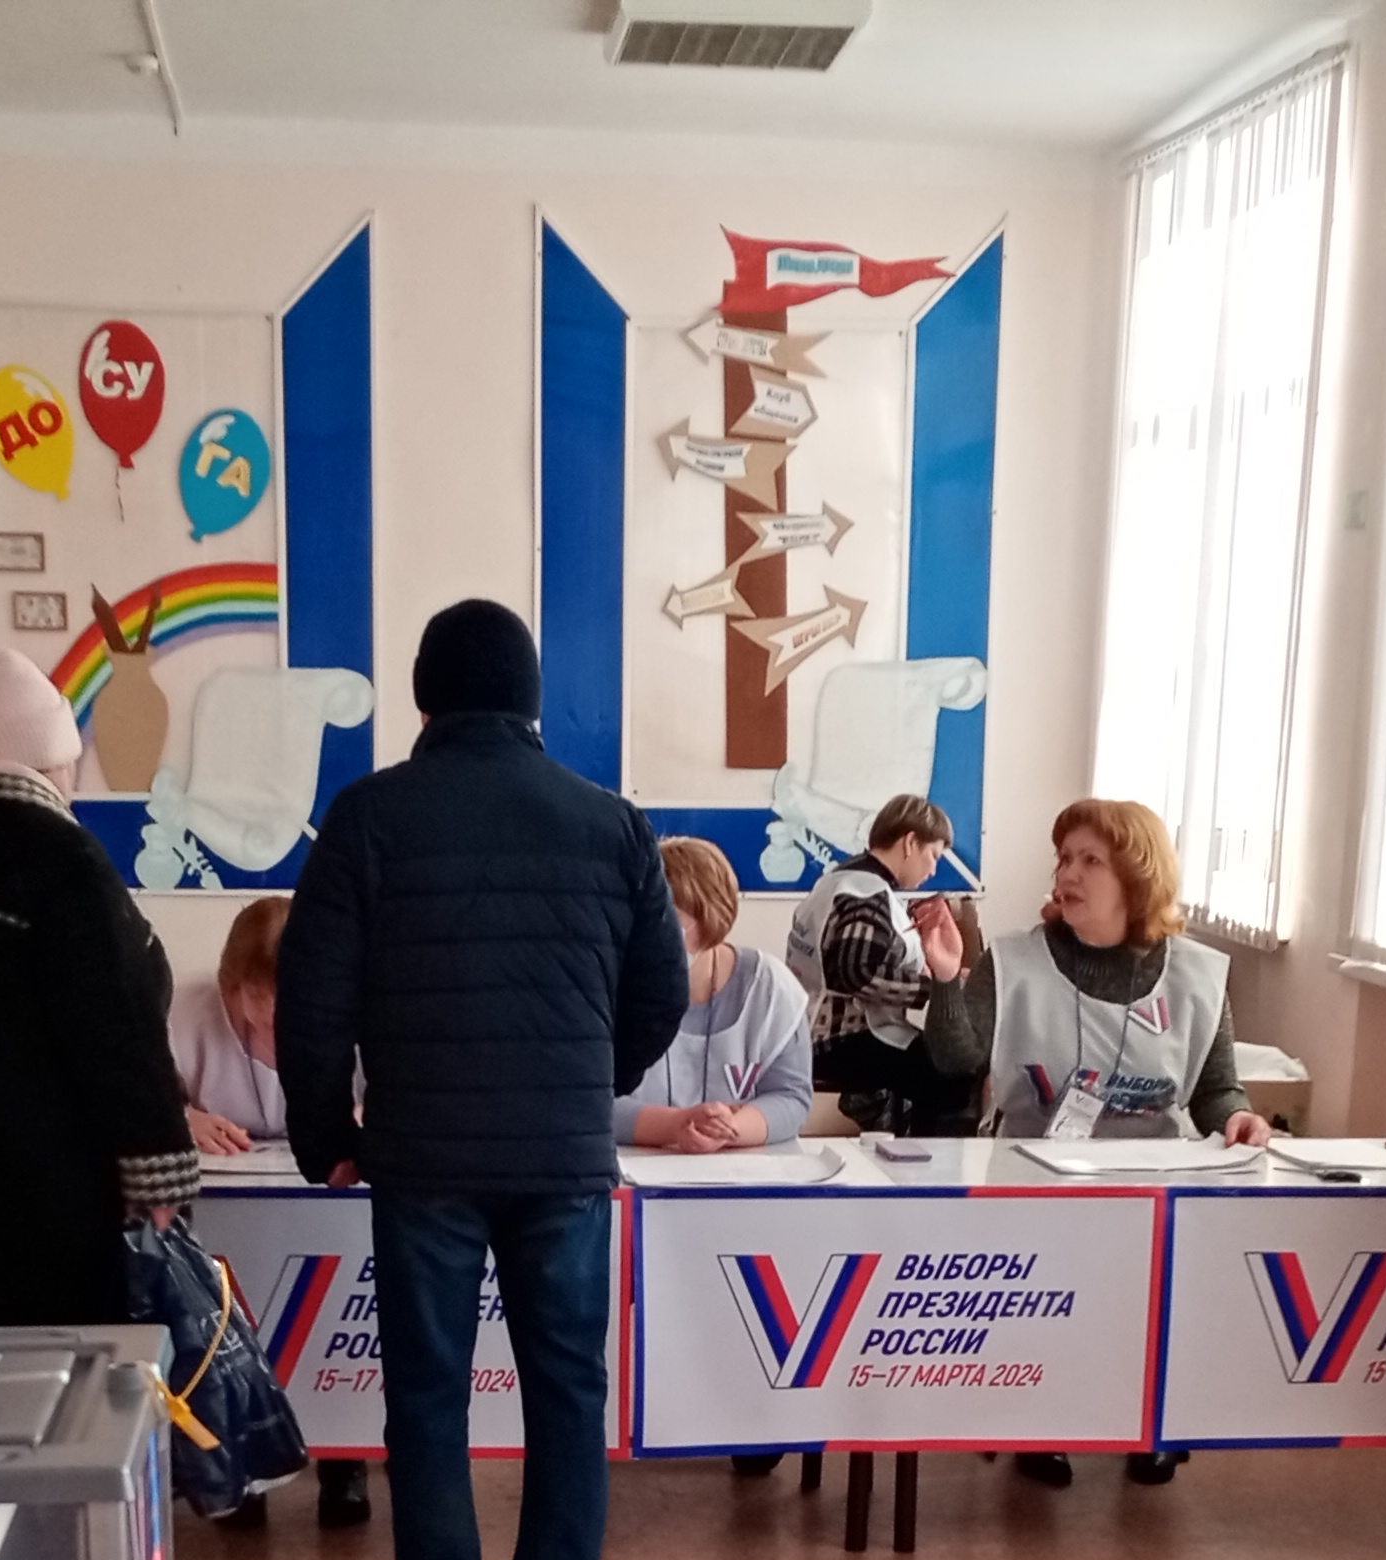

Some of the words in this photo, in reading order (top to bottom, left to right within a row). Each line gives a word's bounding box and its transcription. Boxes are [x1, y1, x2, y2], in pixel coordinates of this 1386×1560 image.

[194, 442, 253, 498] ГА
[894, 1253, 1039, 1281] ВЫБОРЫ
[876, 1290, 1076, 1322] ПРЕЗИДЕНТА
[324, 1332, 383, 1360] РОС
[859, 1328, 990, 1356] РОССИИ
[912, 1363, 987, 1388] МАРТА
[988, 1363, 1044, 1387] 2024
